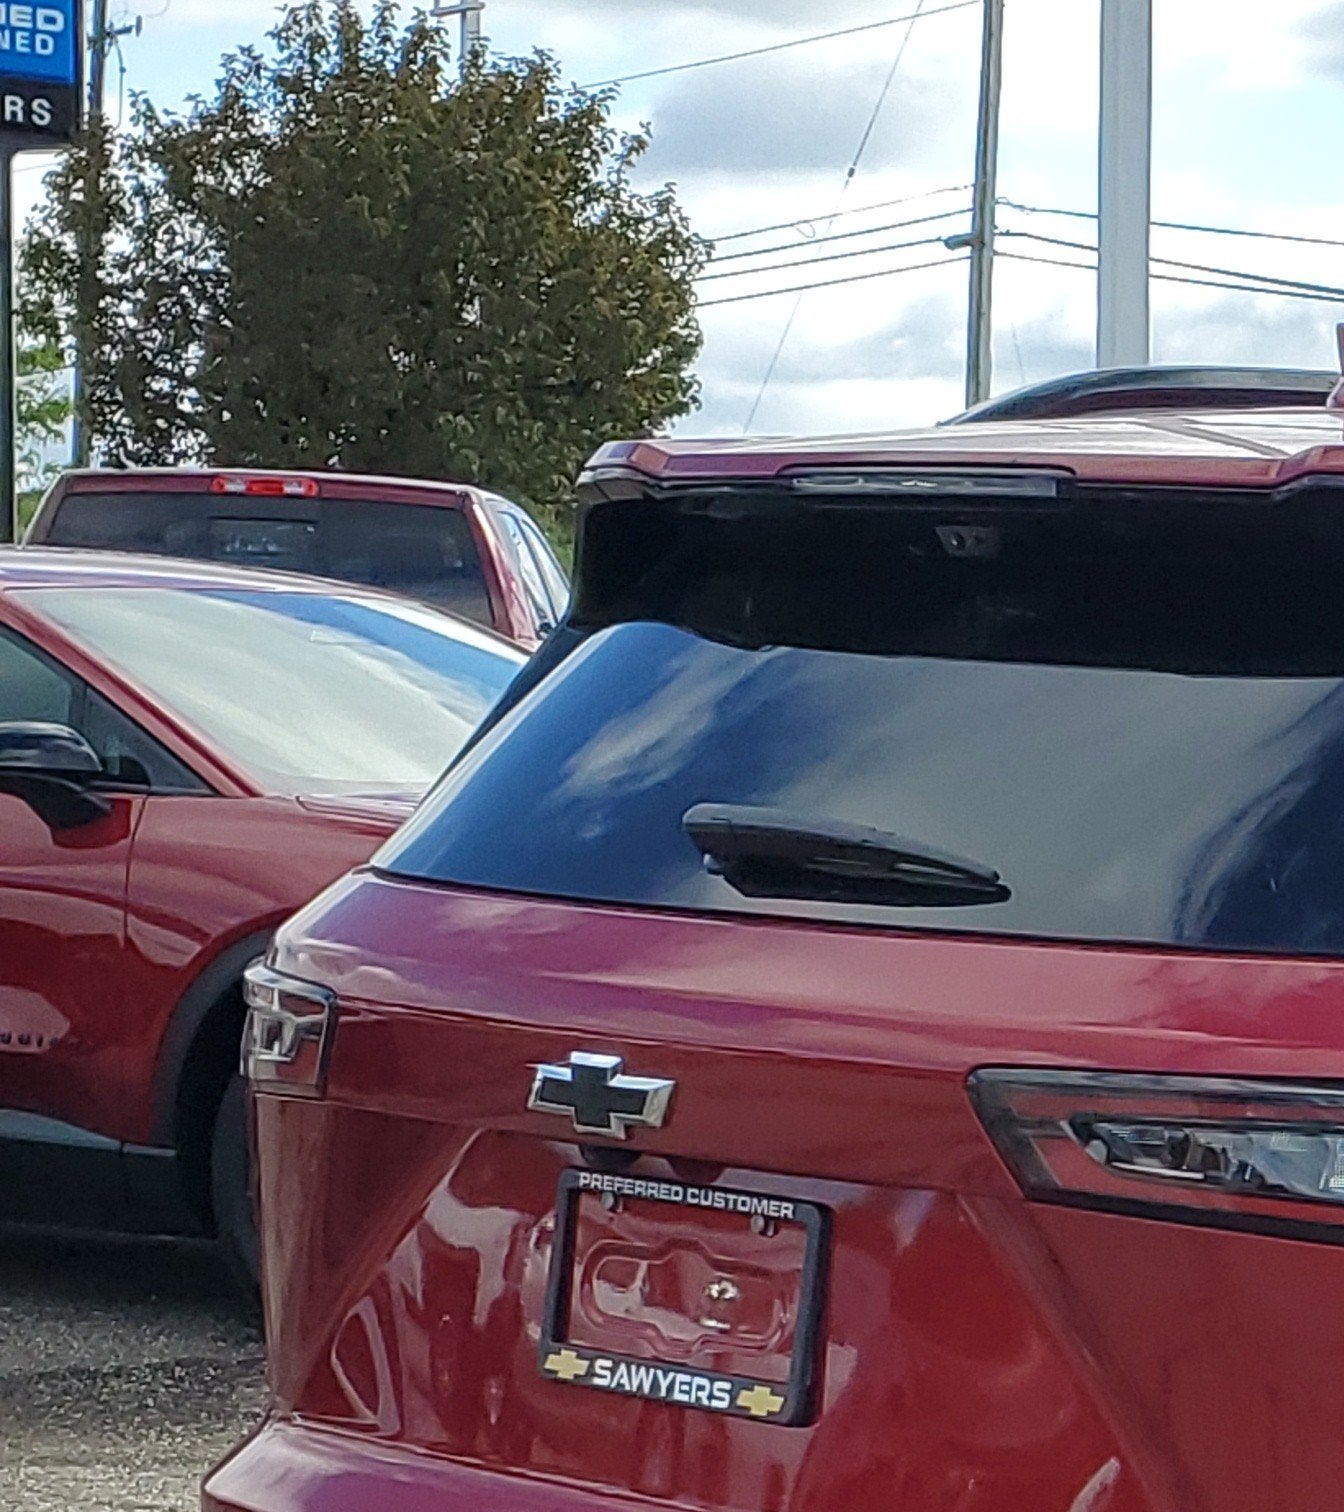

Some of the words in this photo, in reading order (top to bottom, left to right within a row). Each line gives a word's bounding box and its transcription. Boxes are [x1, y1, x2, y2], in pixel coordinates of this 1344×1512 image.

[4, 95, 53, 126] RS
[577, 1172, 683, 1201] PREFERRED
[686, 1187, 795, 1220] CUSTOMER
[592, 1357, 733, 1410] SAWYERS
